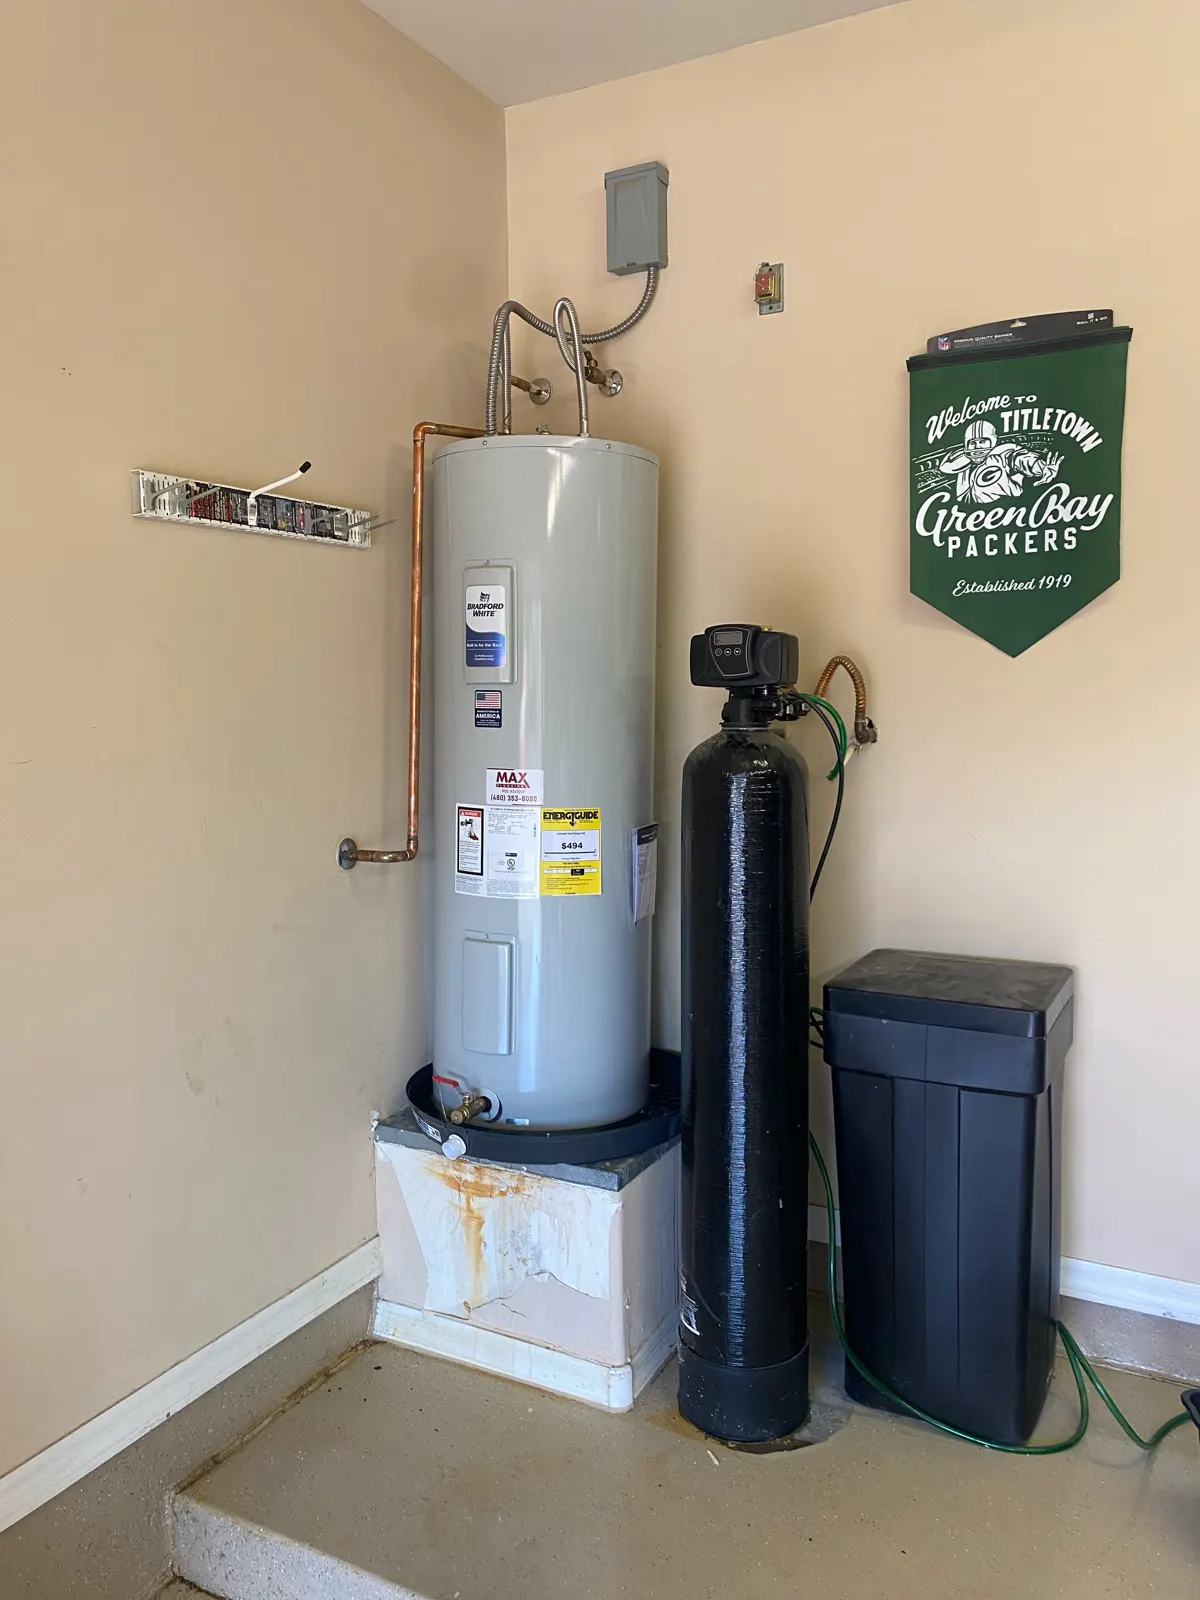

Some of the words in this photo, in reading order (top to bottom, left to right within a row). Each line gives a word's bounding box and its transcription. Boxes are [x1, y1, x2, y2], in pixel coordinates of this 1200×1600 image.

[926, 395, 1011, 444] Welcome
[1014, 394, 1037, 404] TO
[1000, 407, 1103, 453] TITLETOWN
[915, 491, 1027, 547] Green
[1028, 482, 1114, 531] Bay
[947, 527, 1077, 558] PACKERS
[952, 577, 1035, 597] Established
[1038, 574, 1072, 590] 1919
[496, 771, 529, 785] MAX
[561, 842, 583, 850] $494
